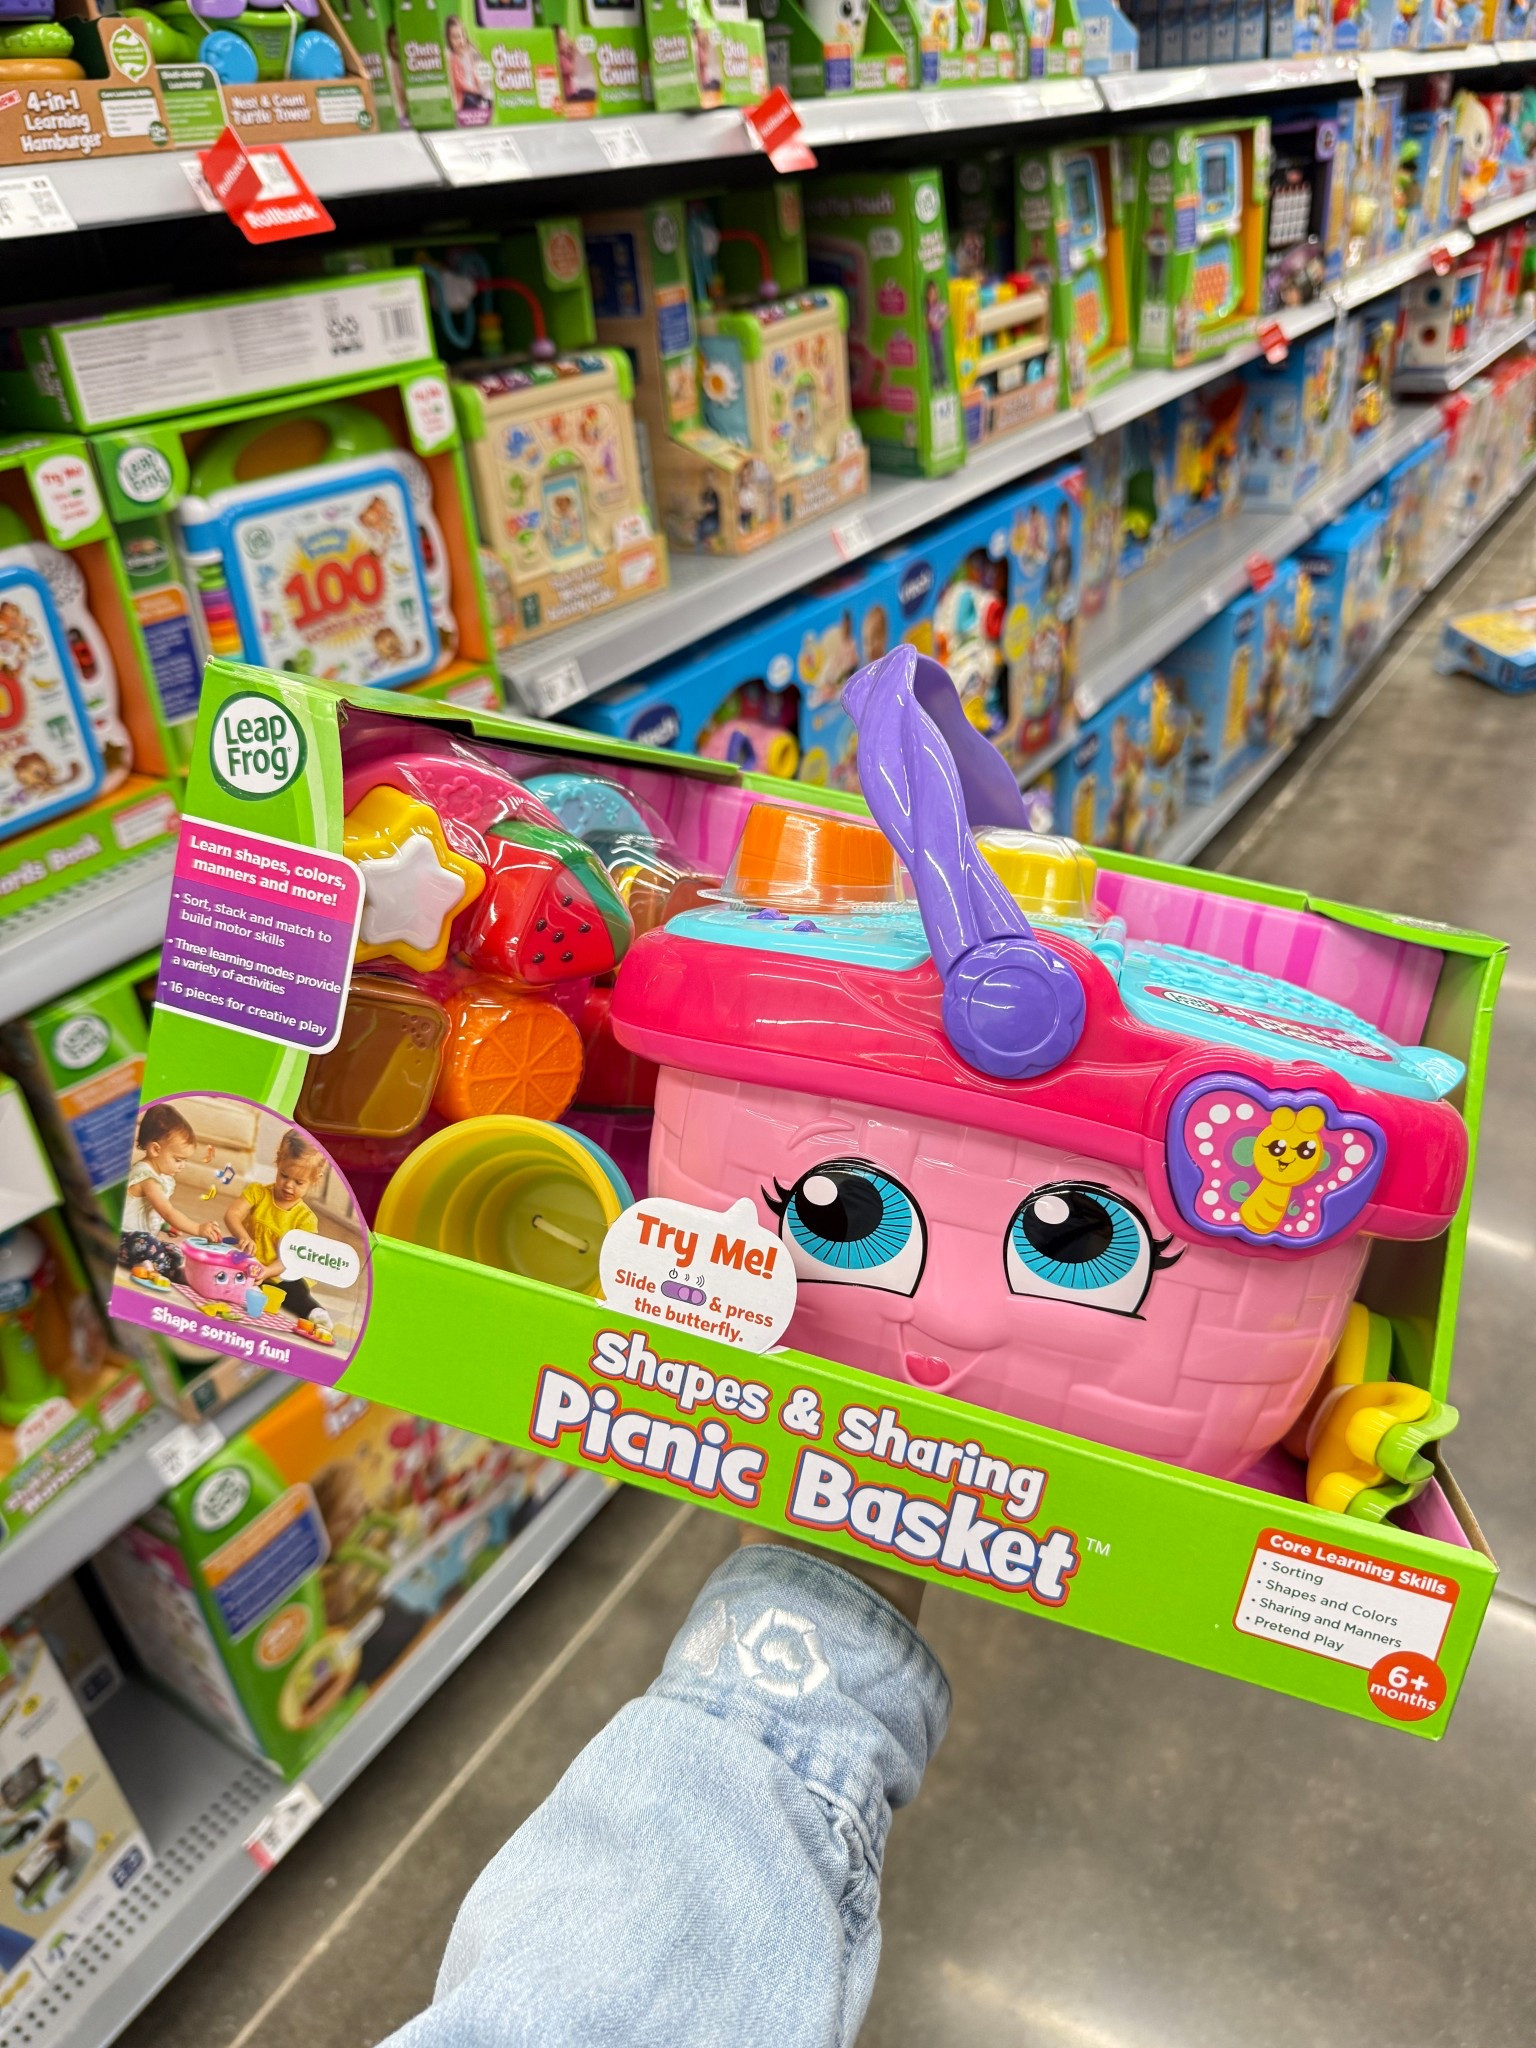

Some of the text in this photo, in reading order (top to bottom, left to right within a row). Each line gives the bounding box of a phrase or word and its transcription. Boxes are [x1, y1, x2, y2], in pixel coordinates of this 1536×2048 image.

[24, 112, 91, 133] Learning
[232, 108, 312, 126] Turtle Tower
[272, 93, 306, 107] Count
[20, 133, 102, 155] Hamburger
[243, 203, 320, 229] Rollback
[283, 554, 384, 629] 100
[224, 714, 286, 746] Leap
[228, 746, 288, 781] Frog
[190, 835, 346, 891] Learn shapes, colors,
[194, 858, 338, 907] manners and more!
[181, 908, 286, 948] build motor skills
[183, 893, 332, 943] Sort, stack and match to
[173, 956, 286, 995] a variety of activities
[175, 938, 341, 995] Three learning modes provide
[170, 981, 327, 1037] 16 pieces for creative play
[289, 1244, 350, 1271] “Circle!”
[637, 1212, 778, 1280] Try Me!
[615, 1268, 773, 1328] Slide & press
[634, 1297, 743, 1343] the butterfly.
[152, 1306, 291, 1363] Shape sorting fun!
[590, 1330, 1048, 1521] Shapes & Sharing
[531, 1367, 767, 1506] Picnic
[787, 1447, 1080, 1606] Basket
[1269, 1534, 1447, 1595] Core Learning Skills
[1271, 1560, 1324, 1586] Sorting
[1259, 1597, 1401, 1649] Sharing and Manners
[1265, 1579, 1398, 1627] Shapes and Colors
[1254, 1616, 1345, 1652] Pretend Play
[1370, 1683, 1437, 1711] months
[1388, 1666, 1429, 1691] 6+
